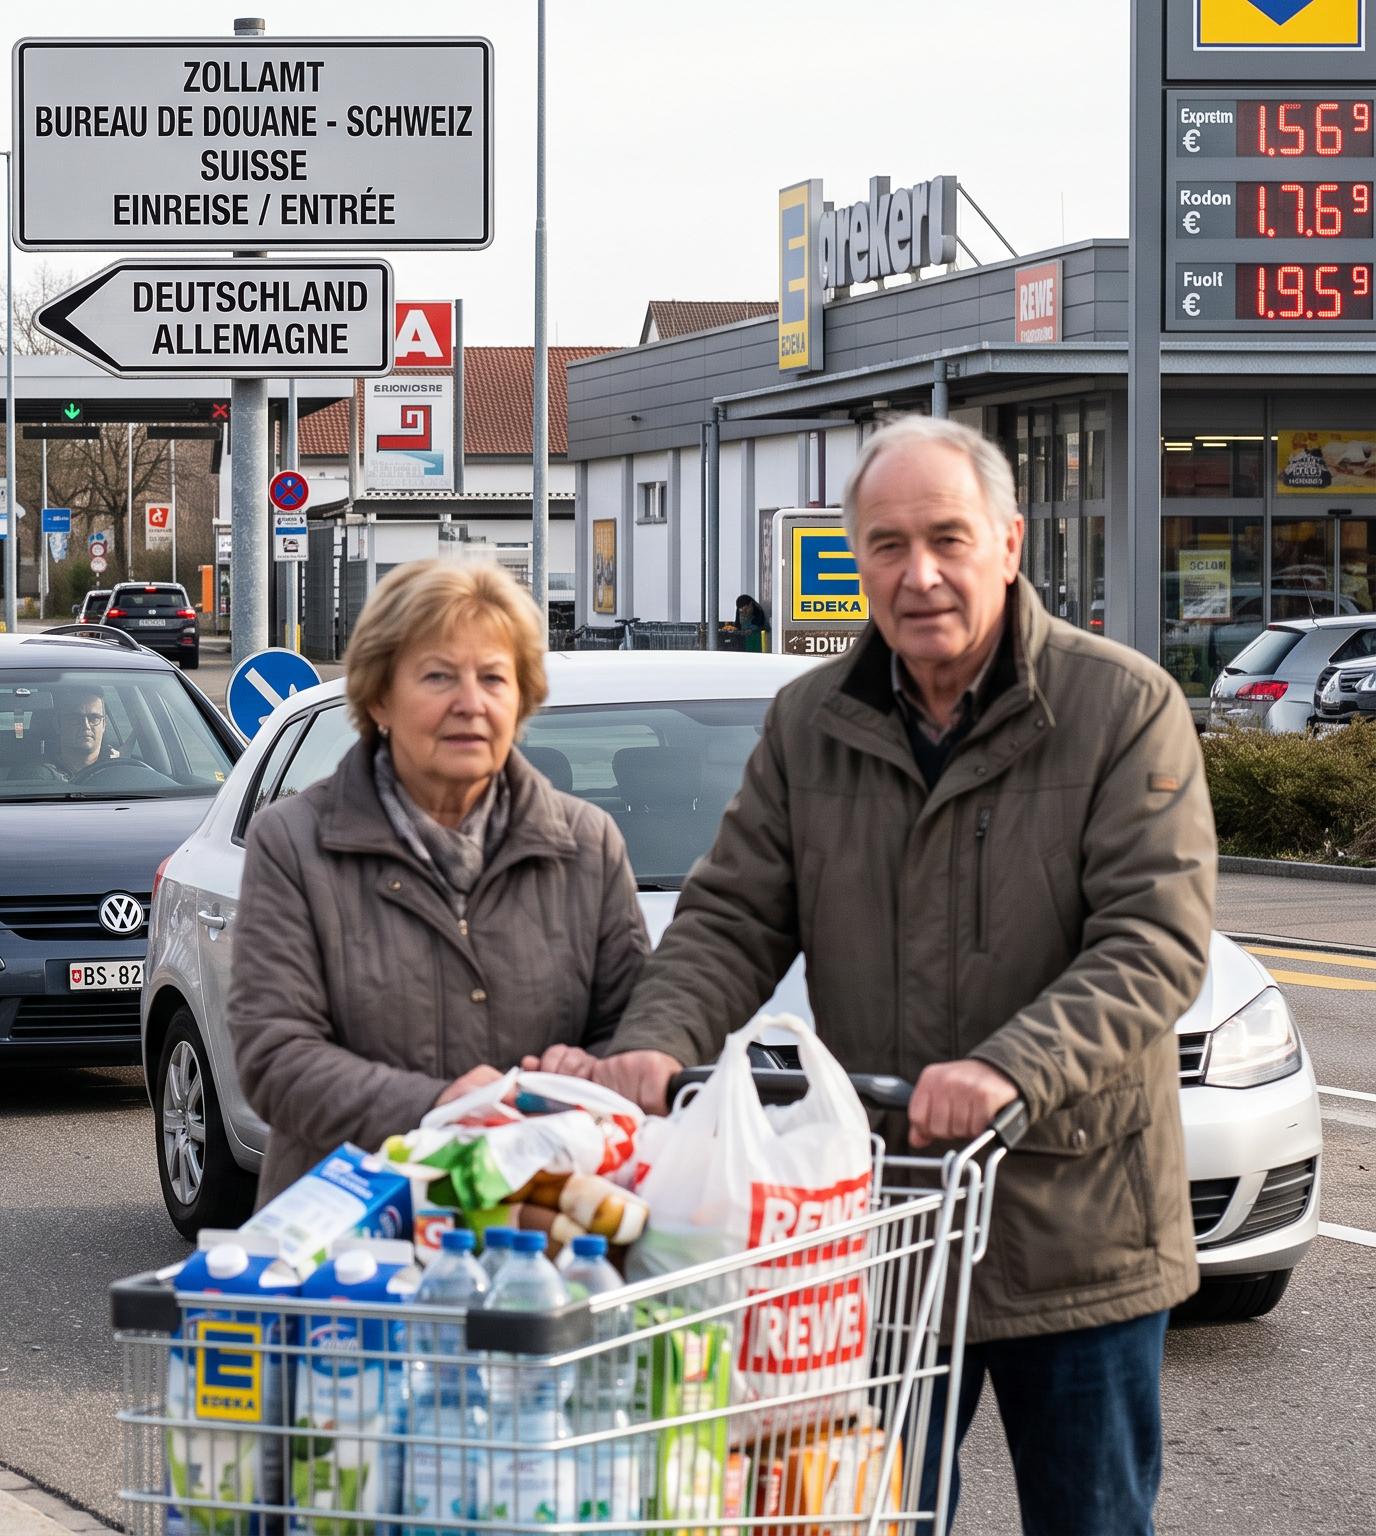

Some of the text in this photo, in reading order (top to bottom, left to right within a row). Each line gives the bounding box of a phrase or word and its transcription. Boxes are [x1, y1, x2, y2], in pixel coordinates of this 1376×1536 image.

[183, 62, 325, 92] ZOLLAMT
[35, 106, 148, 137] BUREAU
[159, 106, 193, 137] DE
[203, 106, 317, 137] DOUANE
[347, 106, 473, 137] SCHWEIZ
[1182, 129, 1201, 152] €
[200, 150, 308, 181] SUISSE
[113, 187, 396, 226] EINREISE / ENTRÉE
[1180, 190, 1232, 205] Rodon
[1182, 211, 1201, 234] €
[133, 282, 368, 312] DEUTSCHLAND
[1020, 278, 1054, 322] REWE
[1182, 293, 1201, 316] €
[153, 324, 348, 354] ALLEMAGNE
[396, 309, 444, 358] A
[801, 601, 862, 612] EDEKA
[756, 1292, 862, 1361] REWE
